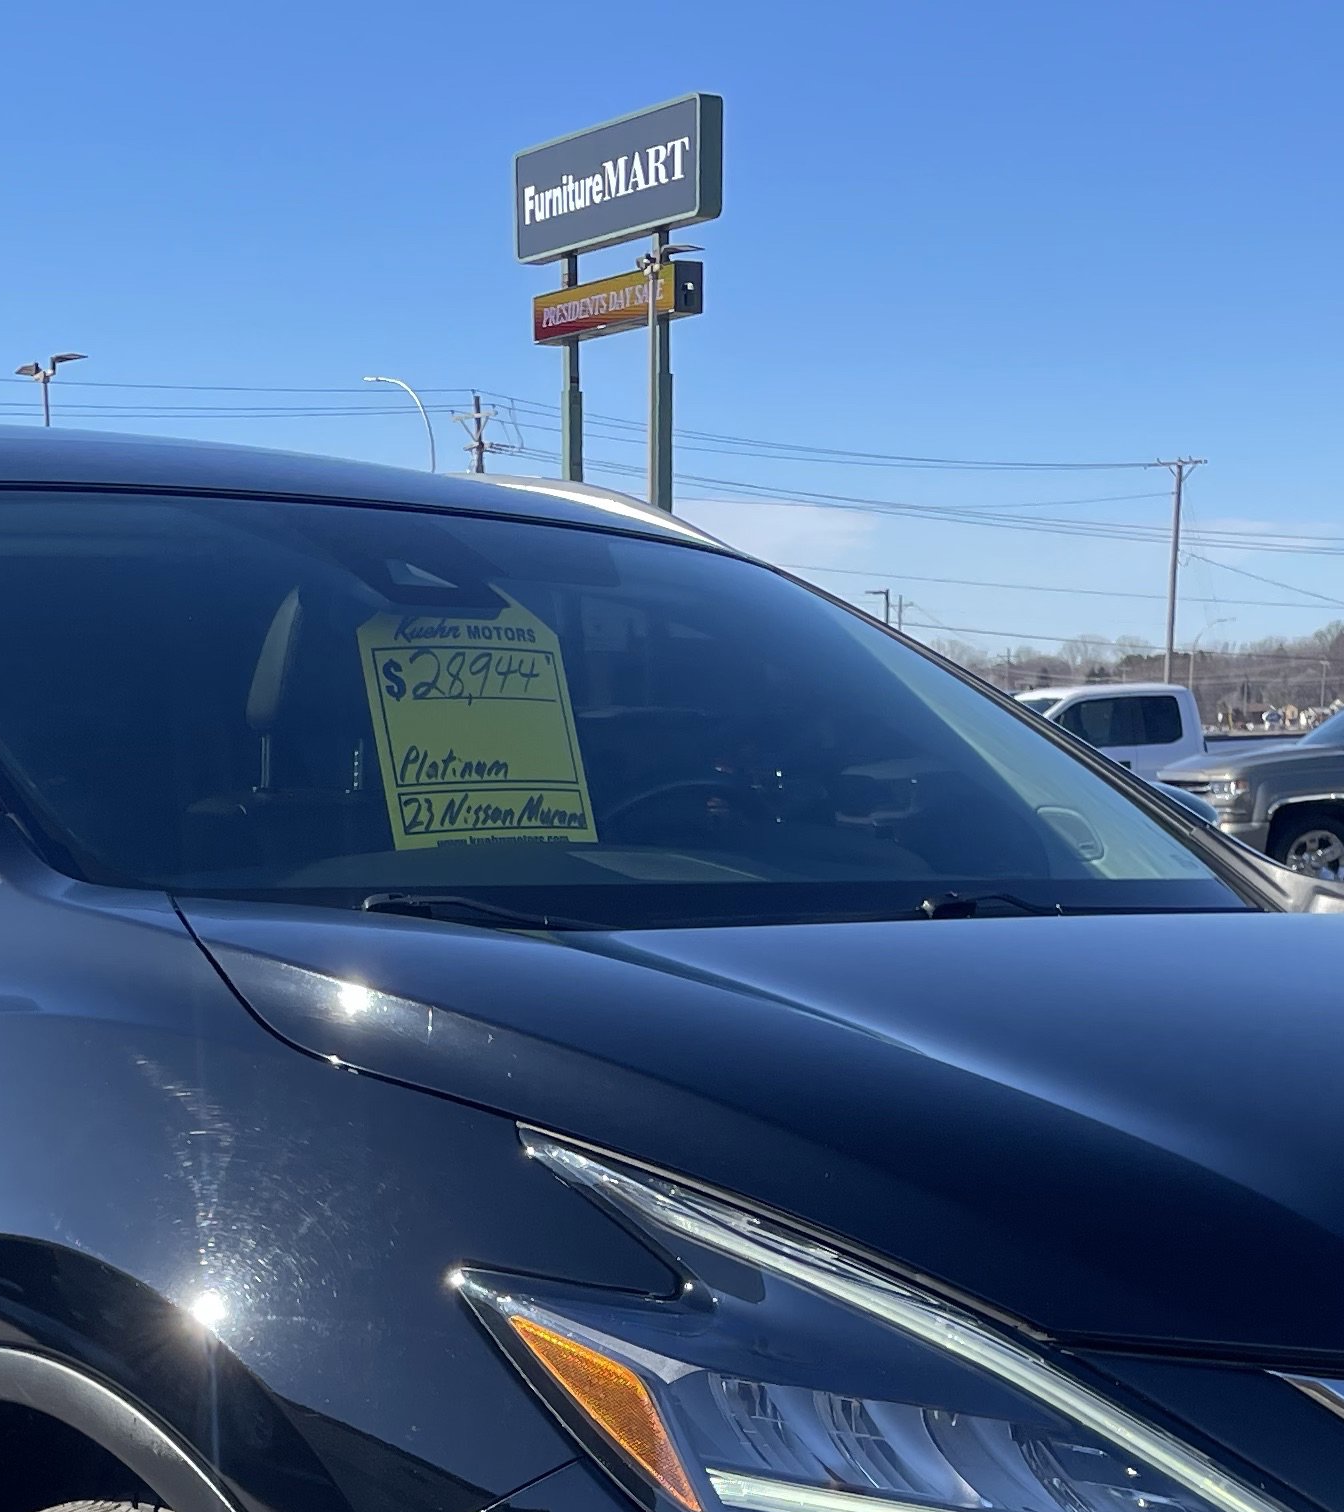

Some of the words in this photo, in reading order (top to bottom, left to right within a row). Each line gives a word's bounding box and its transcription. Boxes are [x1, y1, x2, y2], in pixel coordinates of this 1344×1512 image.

[523, 136, 690, 226] FurnitureMART
[542, 293, 607, 329] PRESIDENTS
[608, 287, 634, 313] DAY
[634, 278, 666, 305] SAE
[466, 624, 537, 644] MOTORS
[399, 745, 510, 783] Platinum
[403, 797, 435, 831] 23
